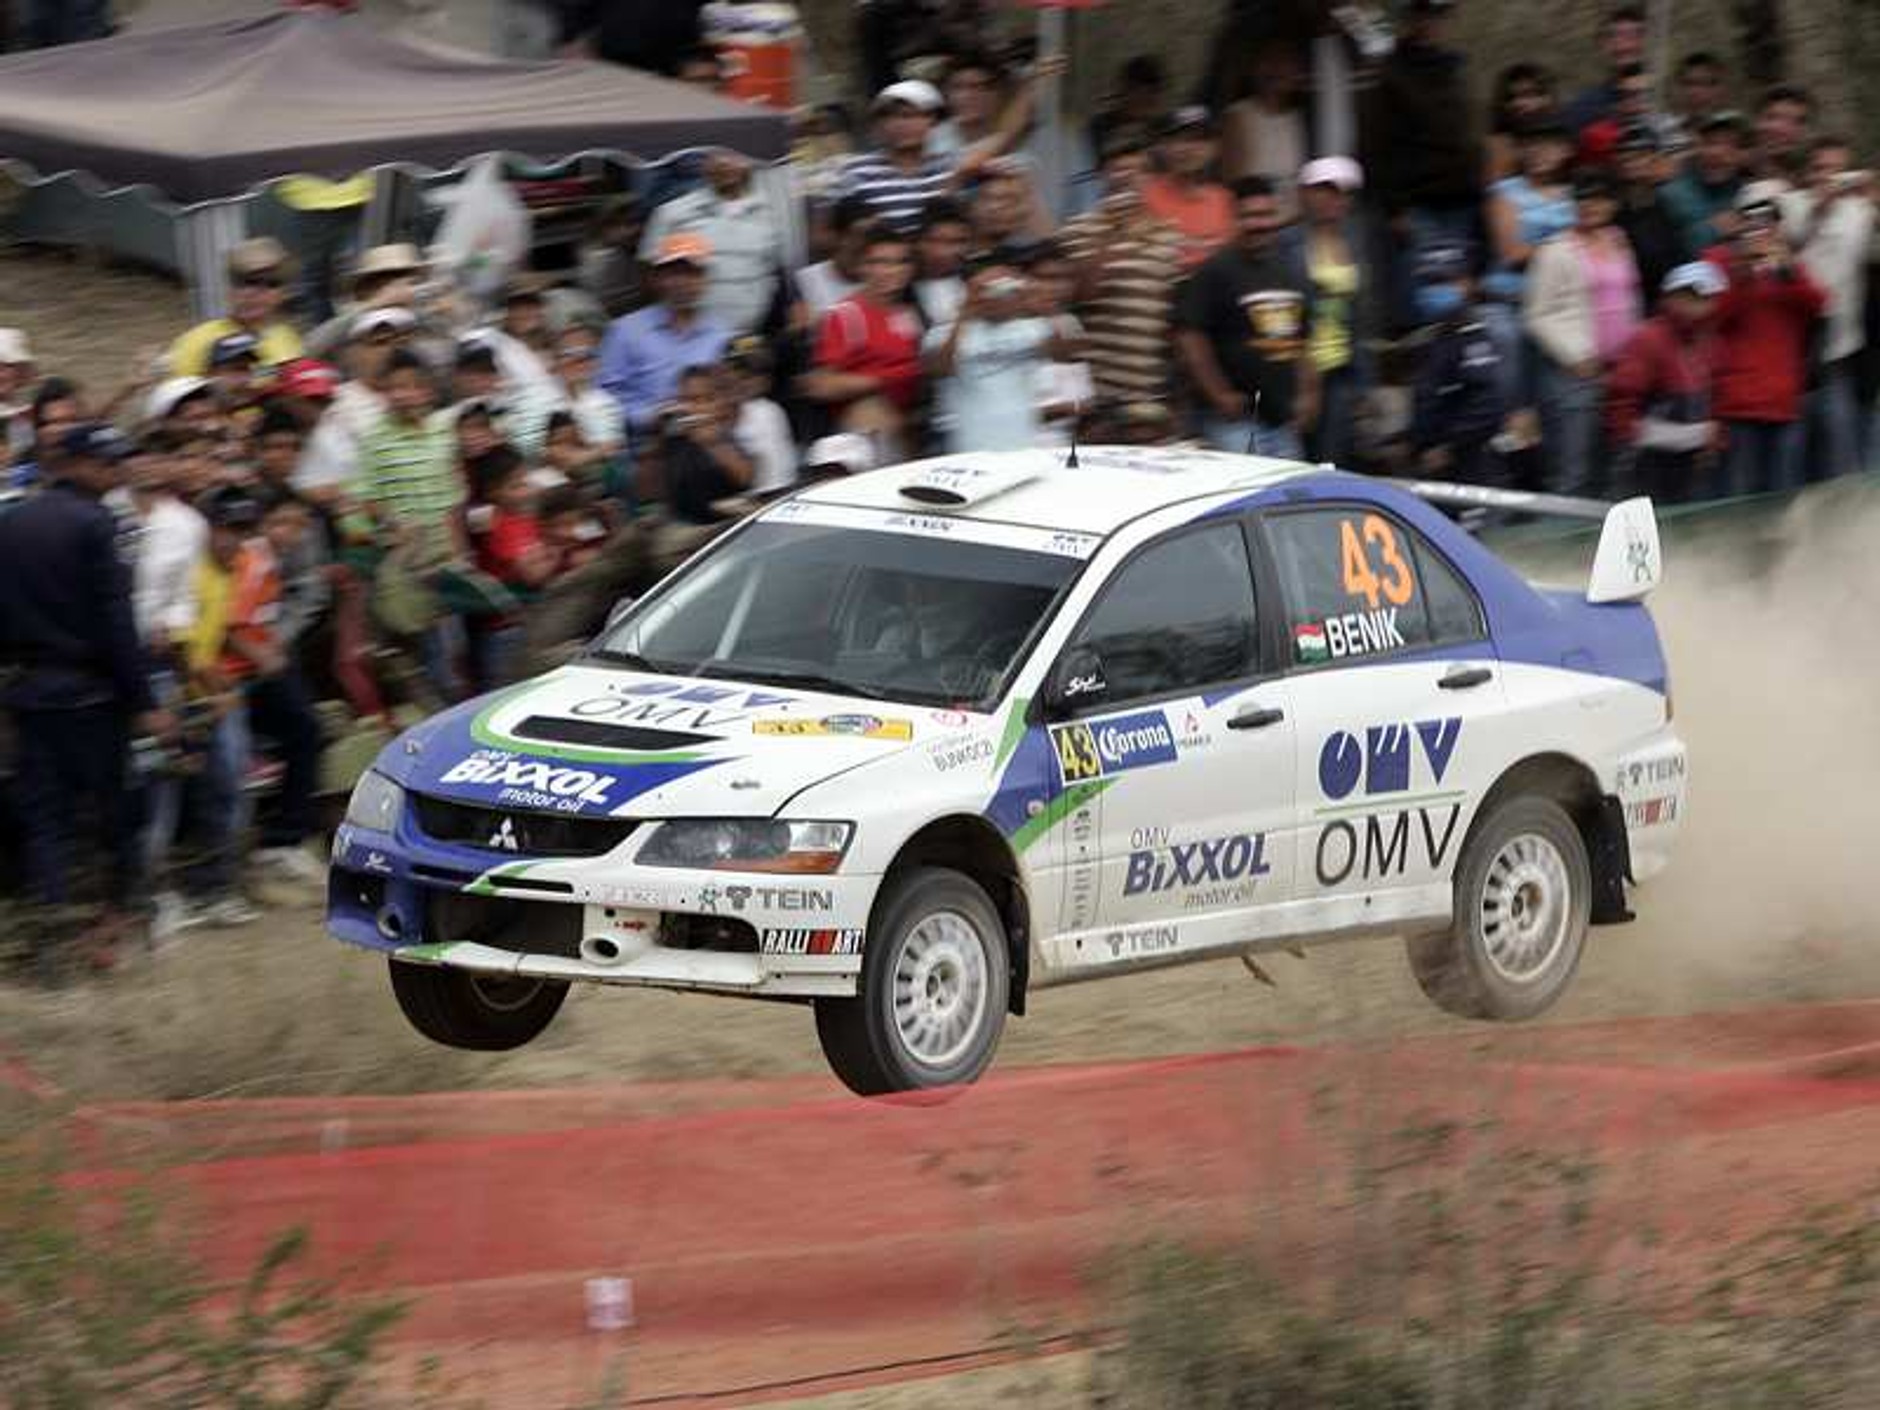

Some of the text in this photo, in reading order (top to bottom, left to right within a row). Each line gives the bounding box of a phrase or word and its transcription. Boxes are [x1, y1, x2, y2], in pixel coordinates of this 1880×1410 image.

[1340, 514, 1414, 608] 43
[1326, 606, 1405, 658] BENIK
[569, 697, 750, 730] OMV
[1060, 722, 1172, 778] 43 Corona
[498, 787, 557, 807] motor
[1131, 826, 1170, 849] OMV
[1315, 802, 1462, 887] OMV
[757, 887, 834, 912] TEIN
[1126, 926, 1179, 950] TEIN
